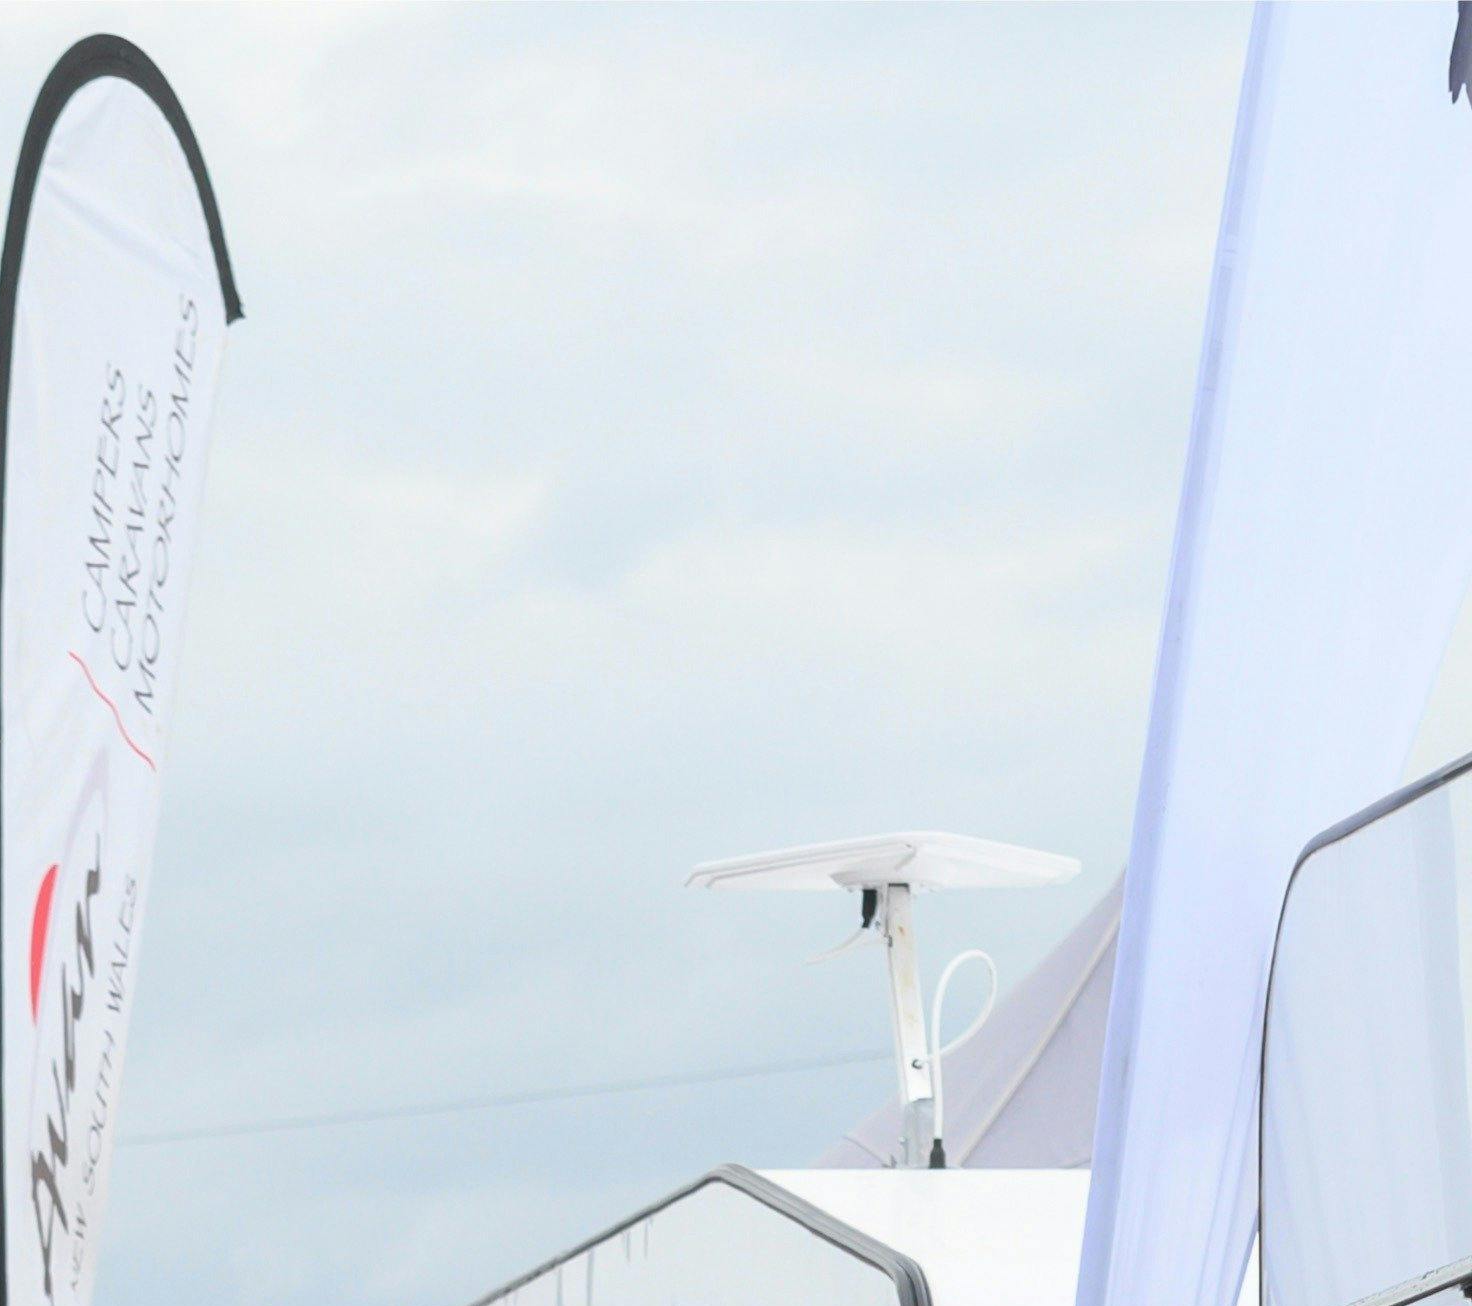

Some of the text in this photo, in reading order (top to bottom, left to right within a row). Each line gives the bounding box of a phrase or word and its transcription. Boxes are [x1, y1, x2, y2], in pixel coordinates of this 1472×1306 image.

[82, 362, 125, 633] CAMPERS
[111, 385, 157, 672] CARAVANS
[133, 294, 199, 714] MOTORHOMES
